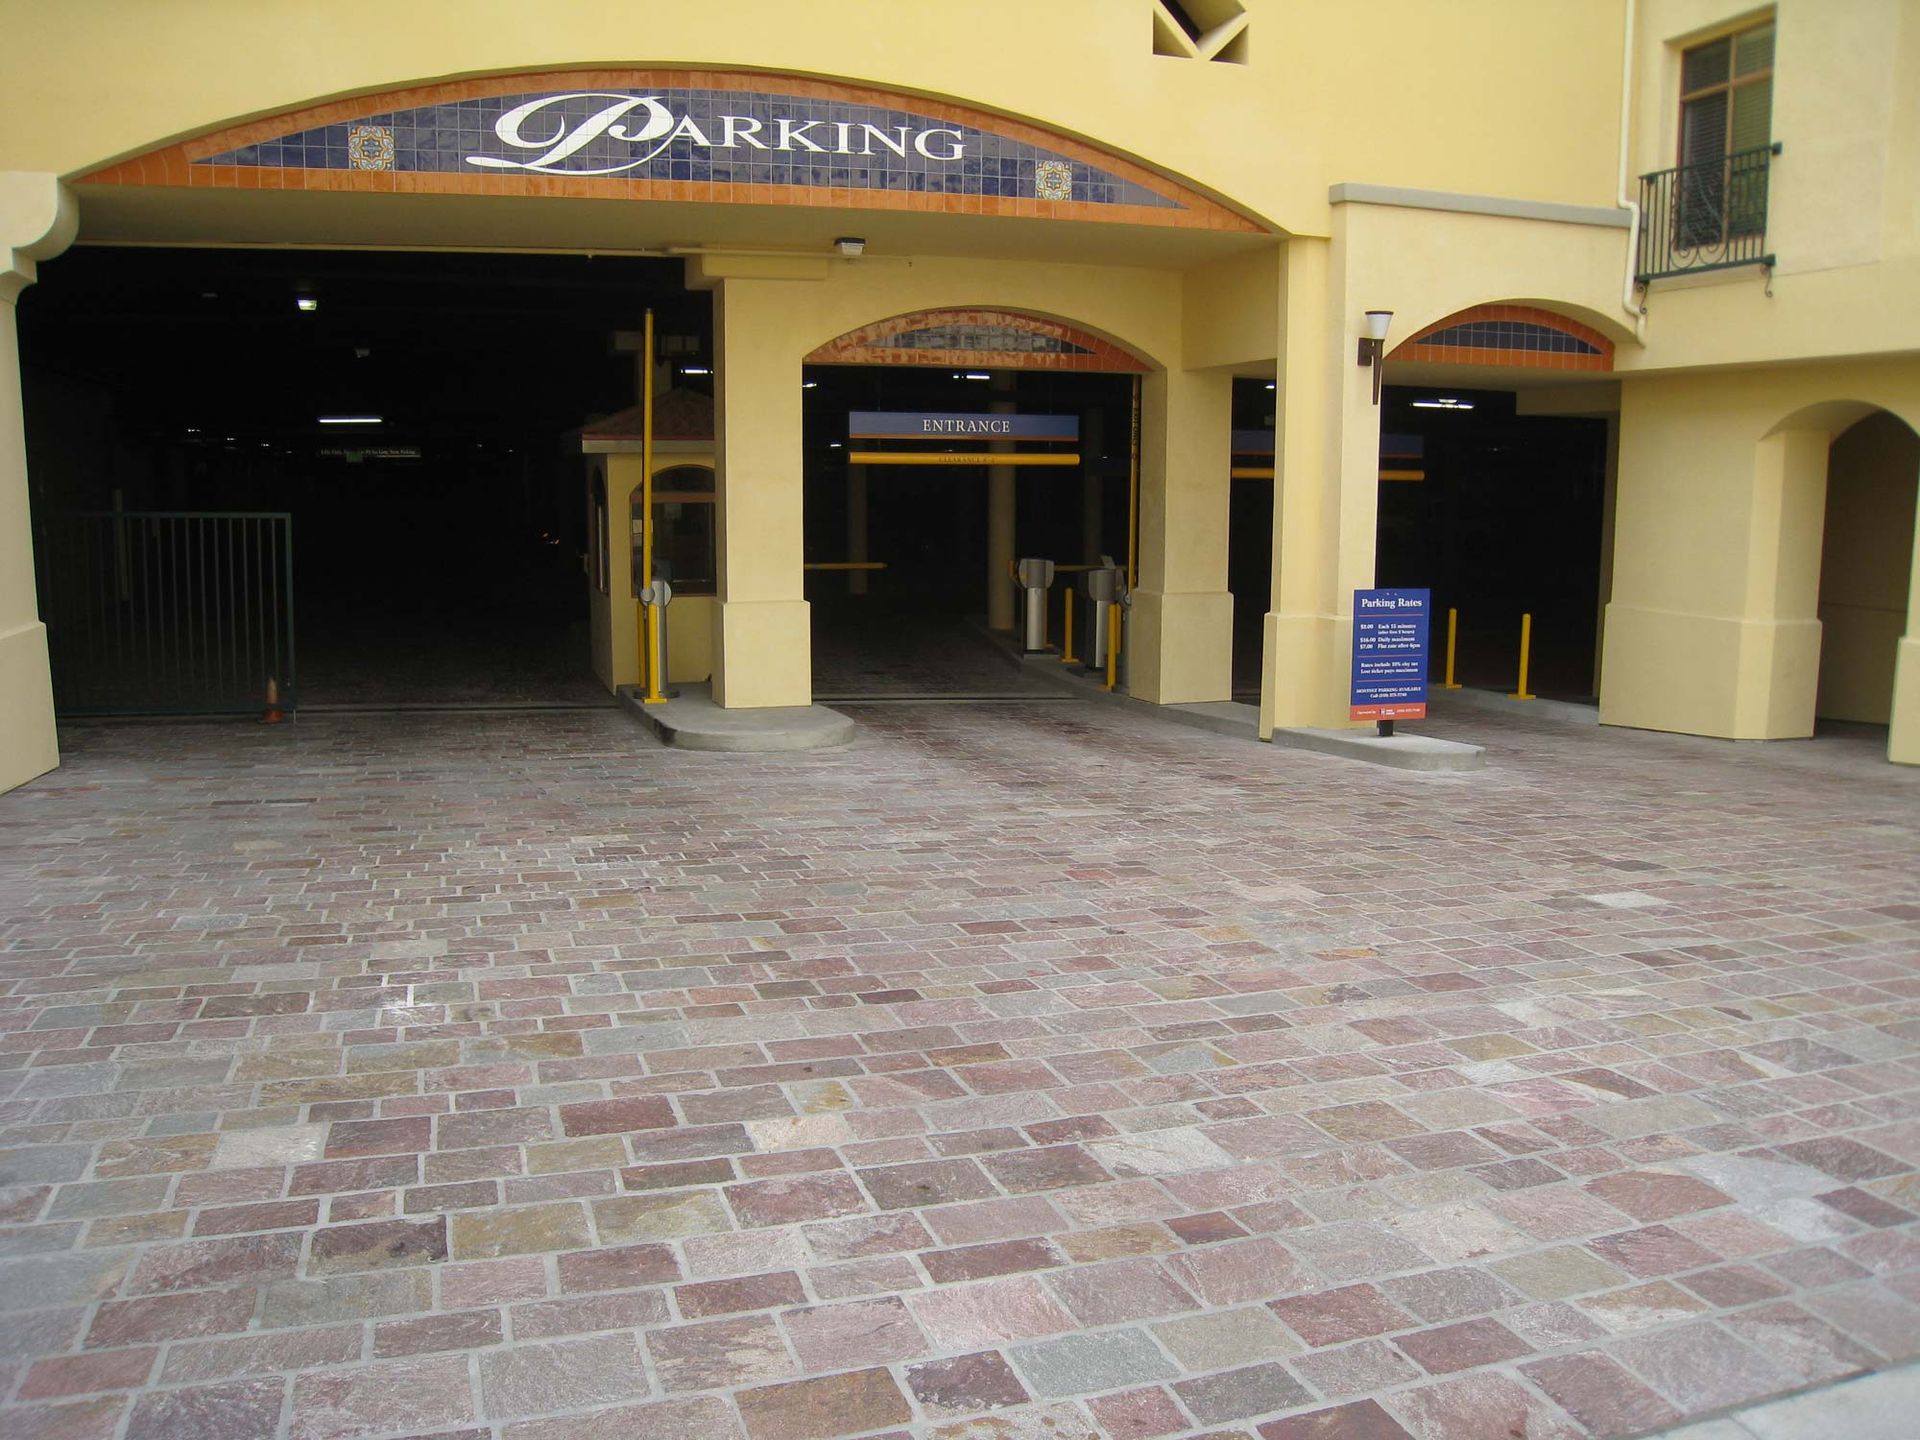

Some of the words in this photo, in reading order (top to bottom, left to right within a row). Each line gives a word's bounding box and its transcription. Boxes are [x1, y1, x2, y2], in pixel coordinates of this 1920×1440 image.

[922, 419, 1011, 433] ENTRANCE
[1361, 598, 1396, 609] Parking
[1398, 597, 1423, 607] Rates
